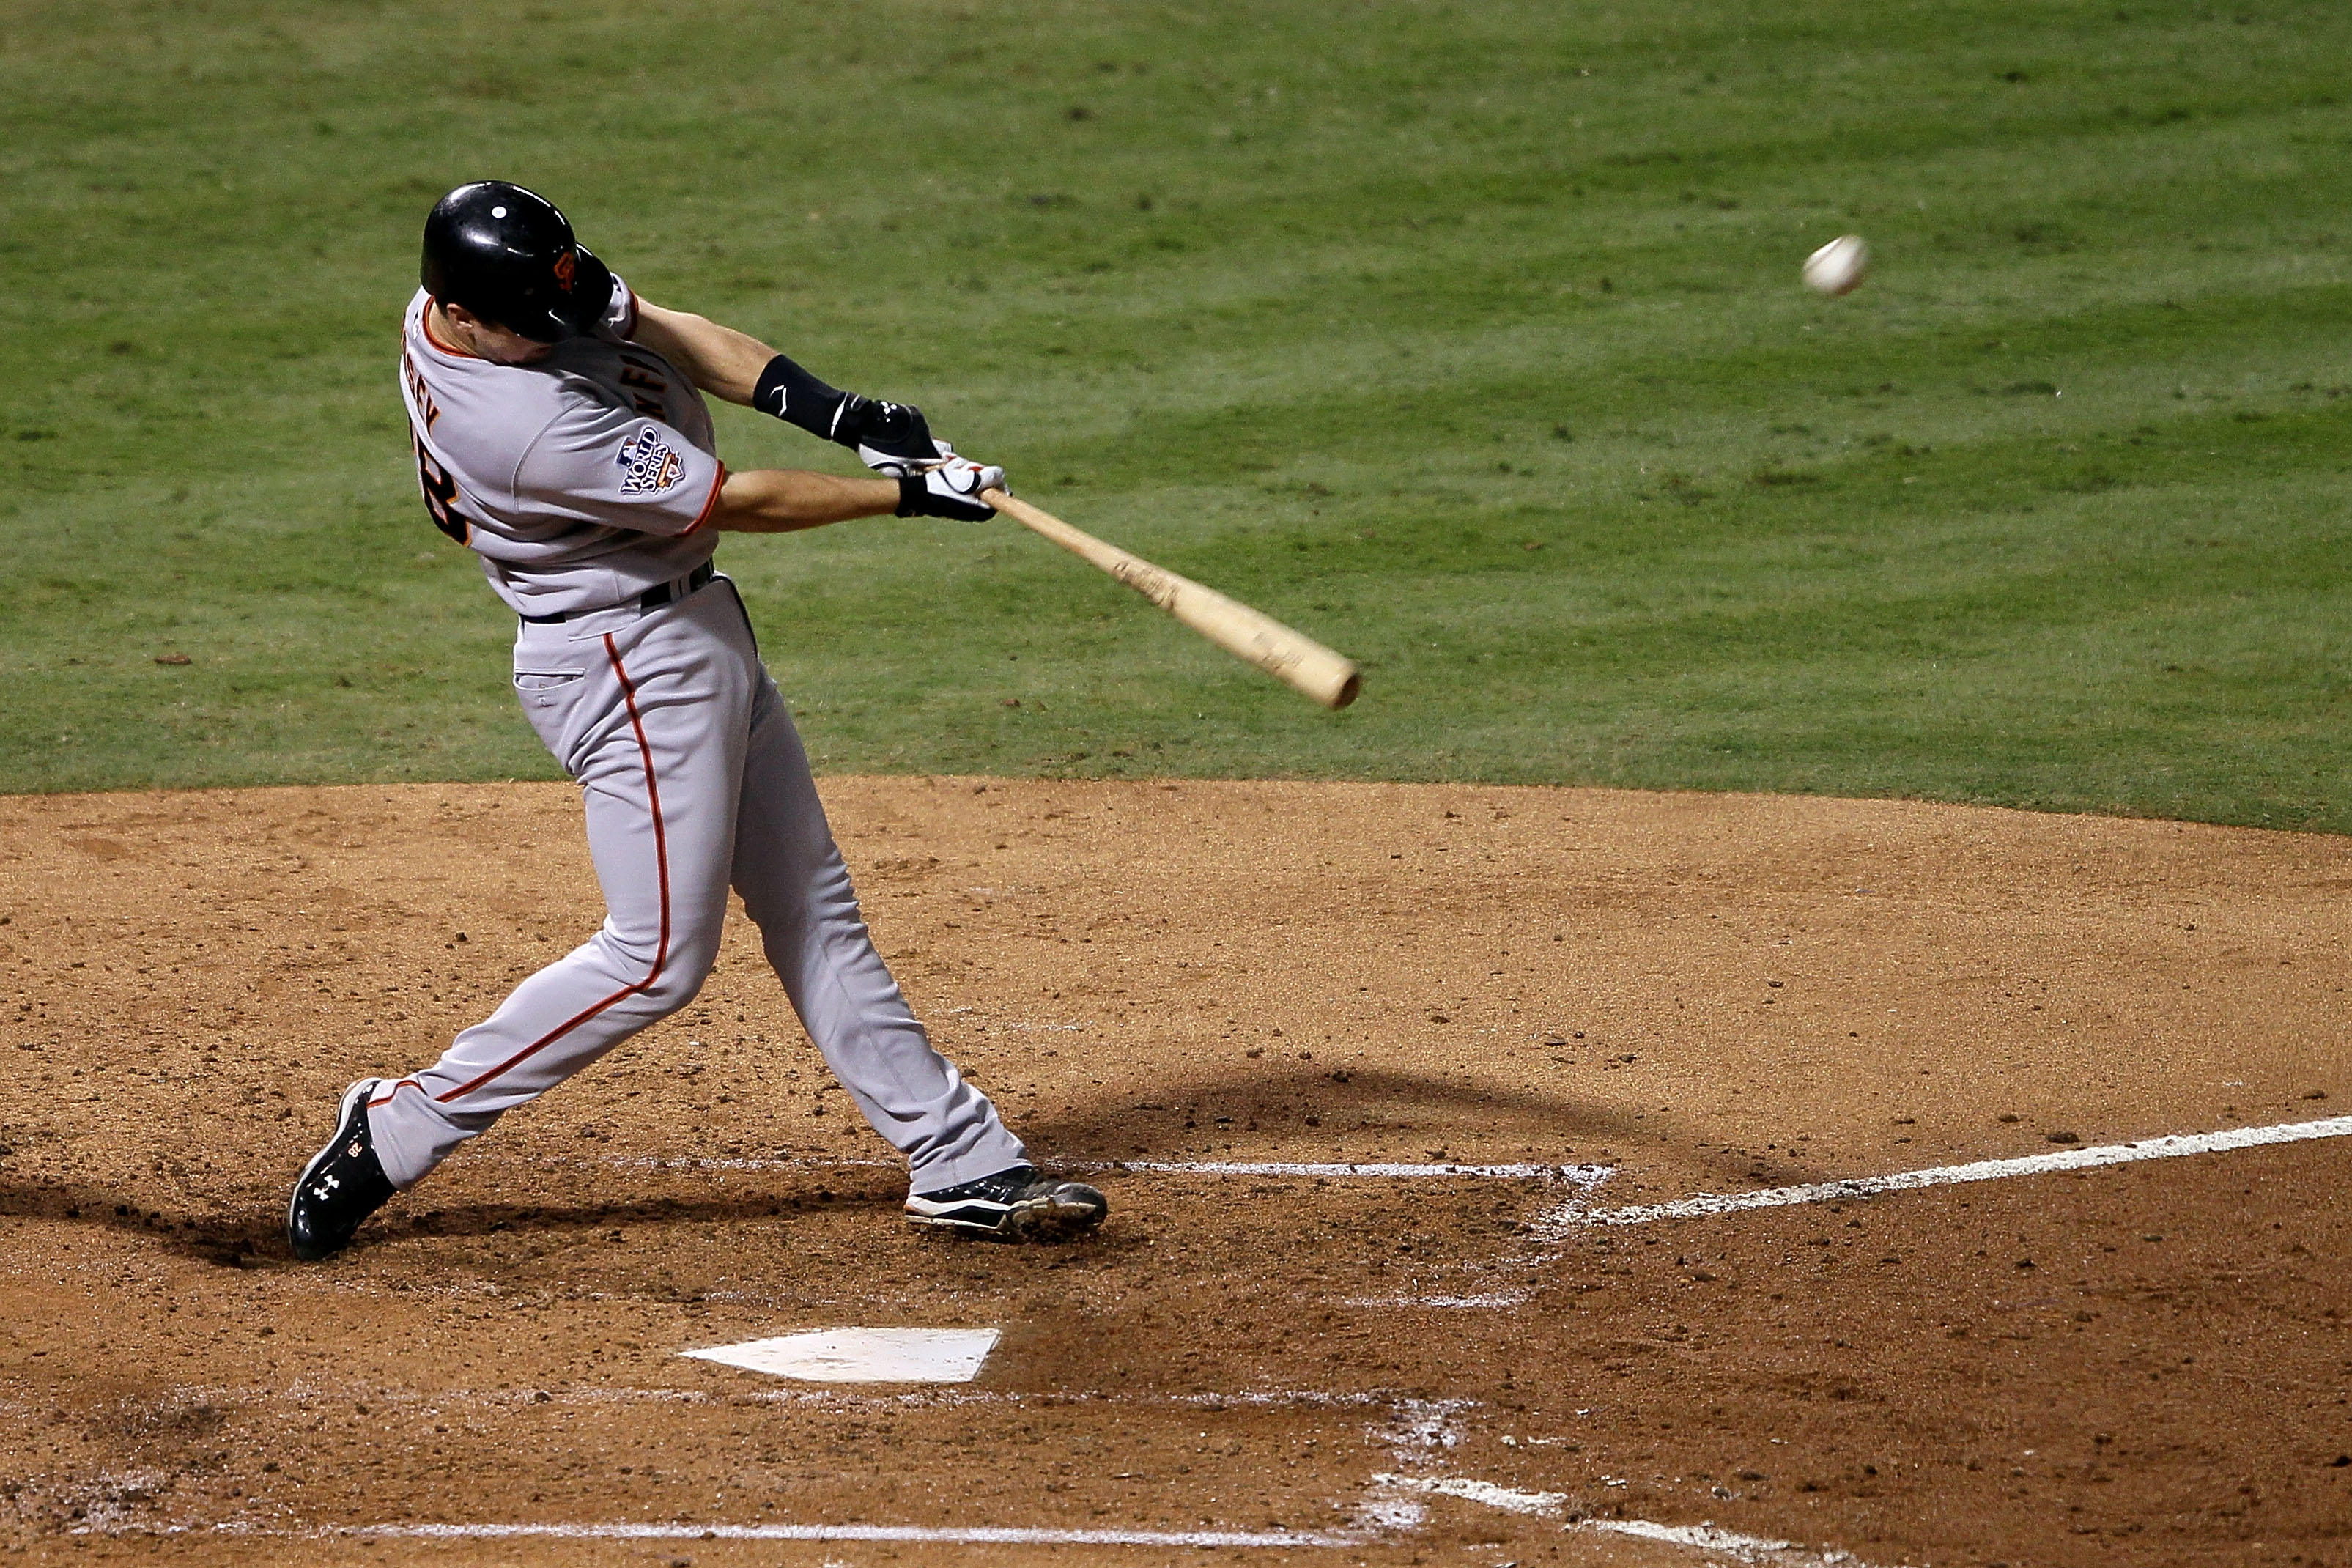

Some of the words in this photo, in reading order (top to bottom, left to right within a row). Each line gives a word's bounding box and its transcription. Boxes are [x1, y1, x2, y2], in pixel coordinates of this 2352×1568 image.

[622, 427, 659, 492] WORLD
[640, 444, 670, 492] SERIES
[347, 1142, 363, 1158] 28
